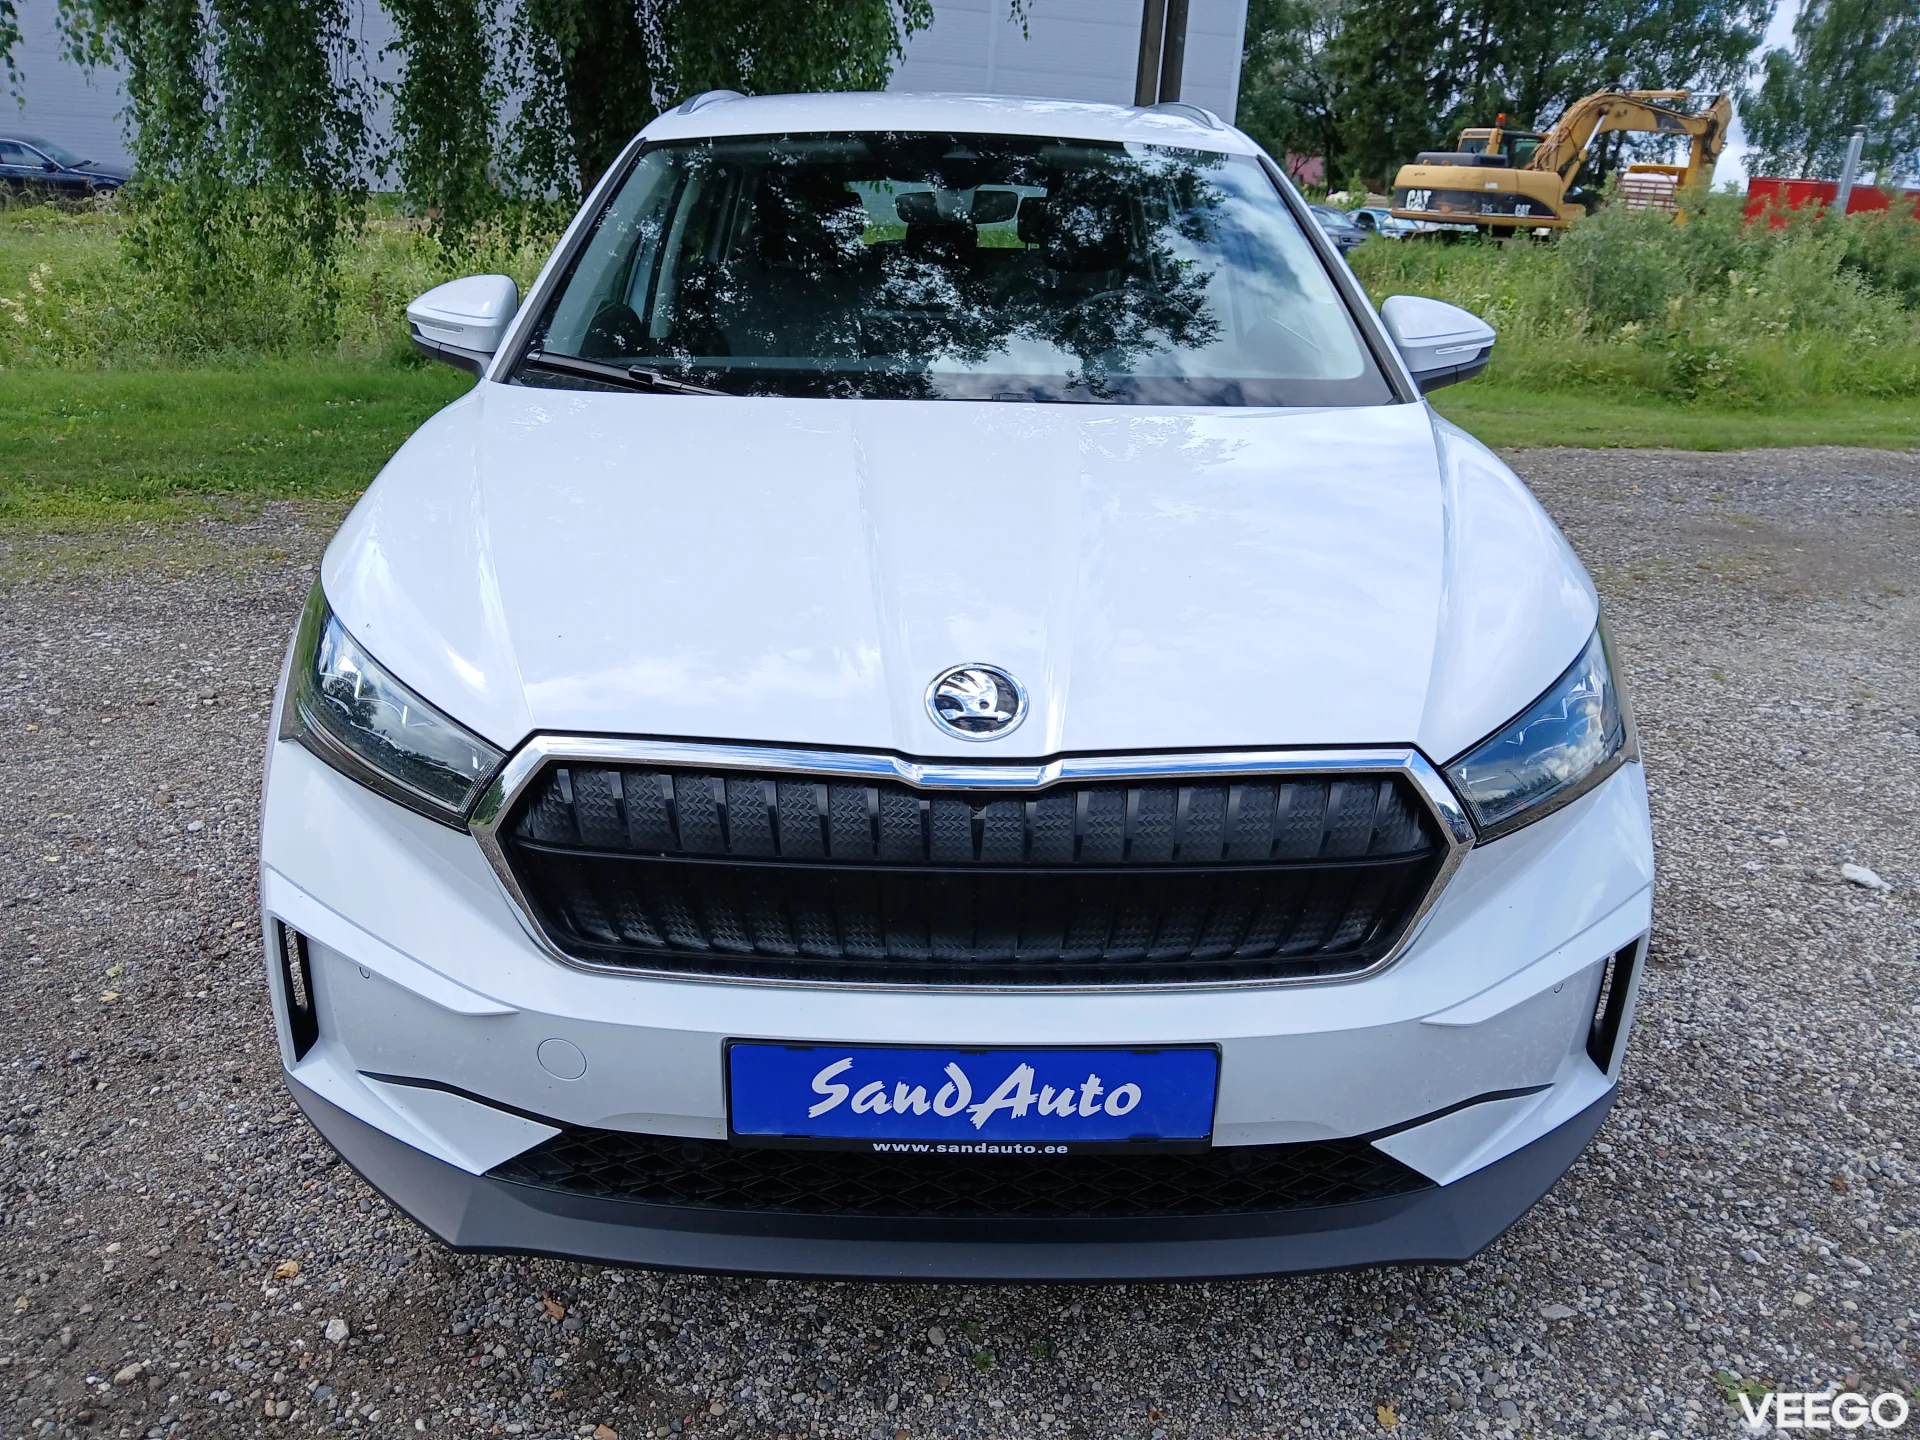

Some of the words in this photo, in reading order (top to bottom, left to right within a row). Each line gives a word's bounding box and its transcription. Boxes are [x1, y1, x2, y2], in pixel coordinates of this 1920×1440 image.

[1406, 190, 1432, 211] CAT
[1515, 204, 1531, 217] CAT
[872, 1143, 1069, 1154] www.sandauto.ee
